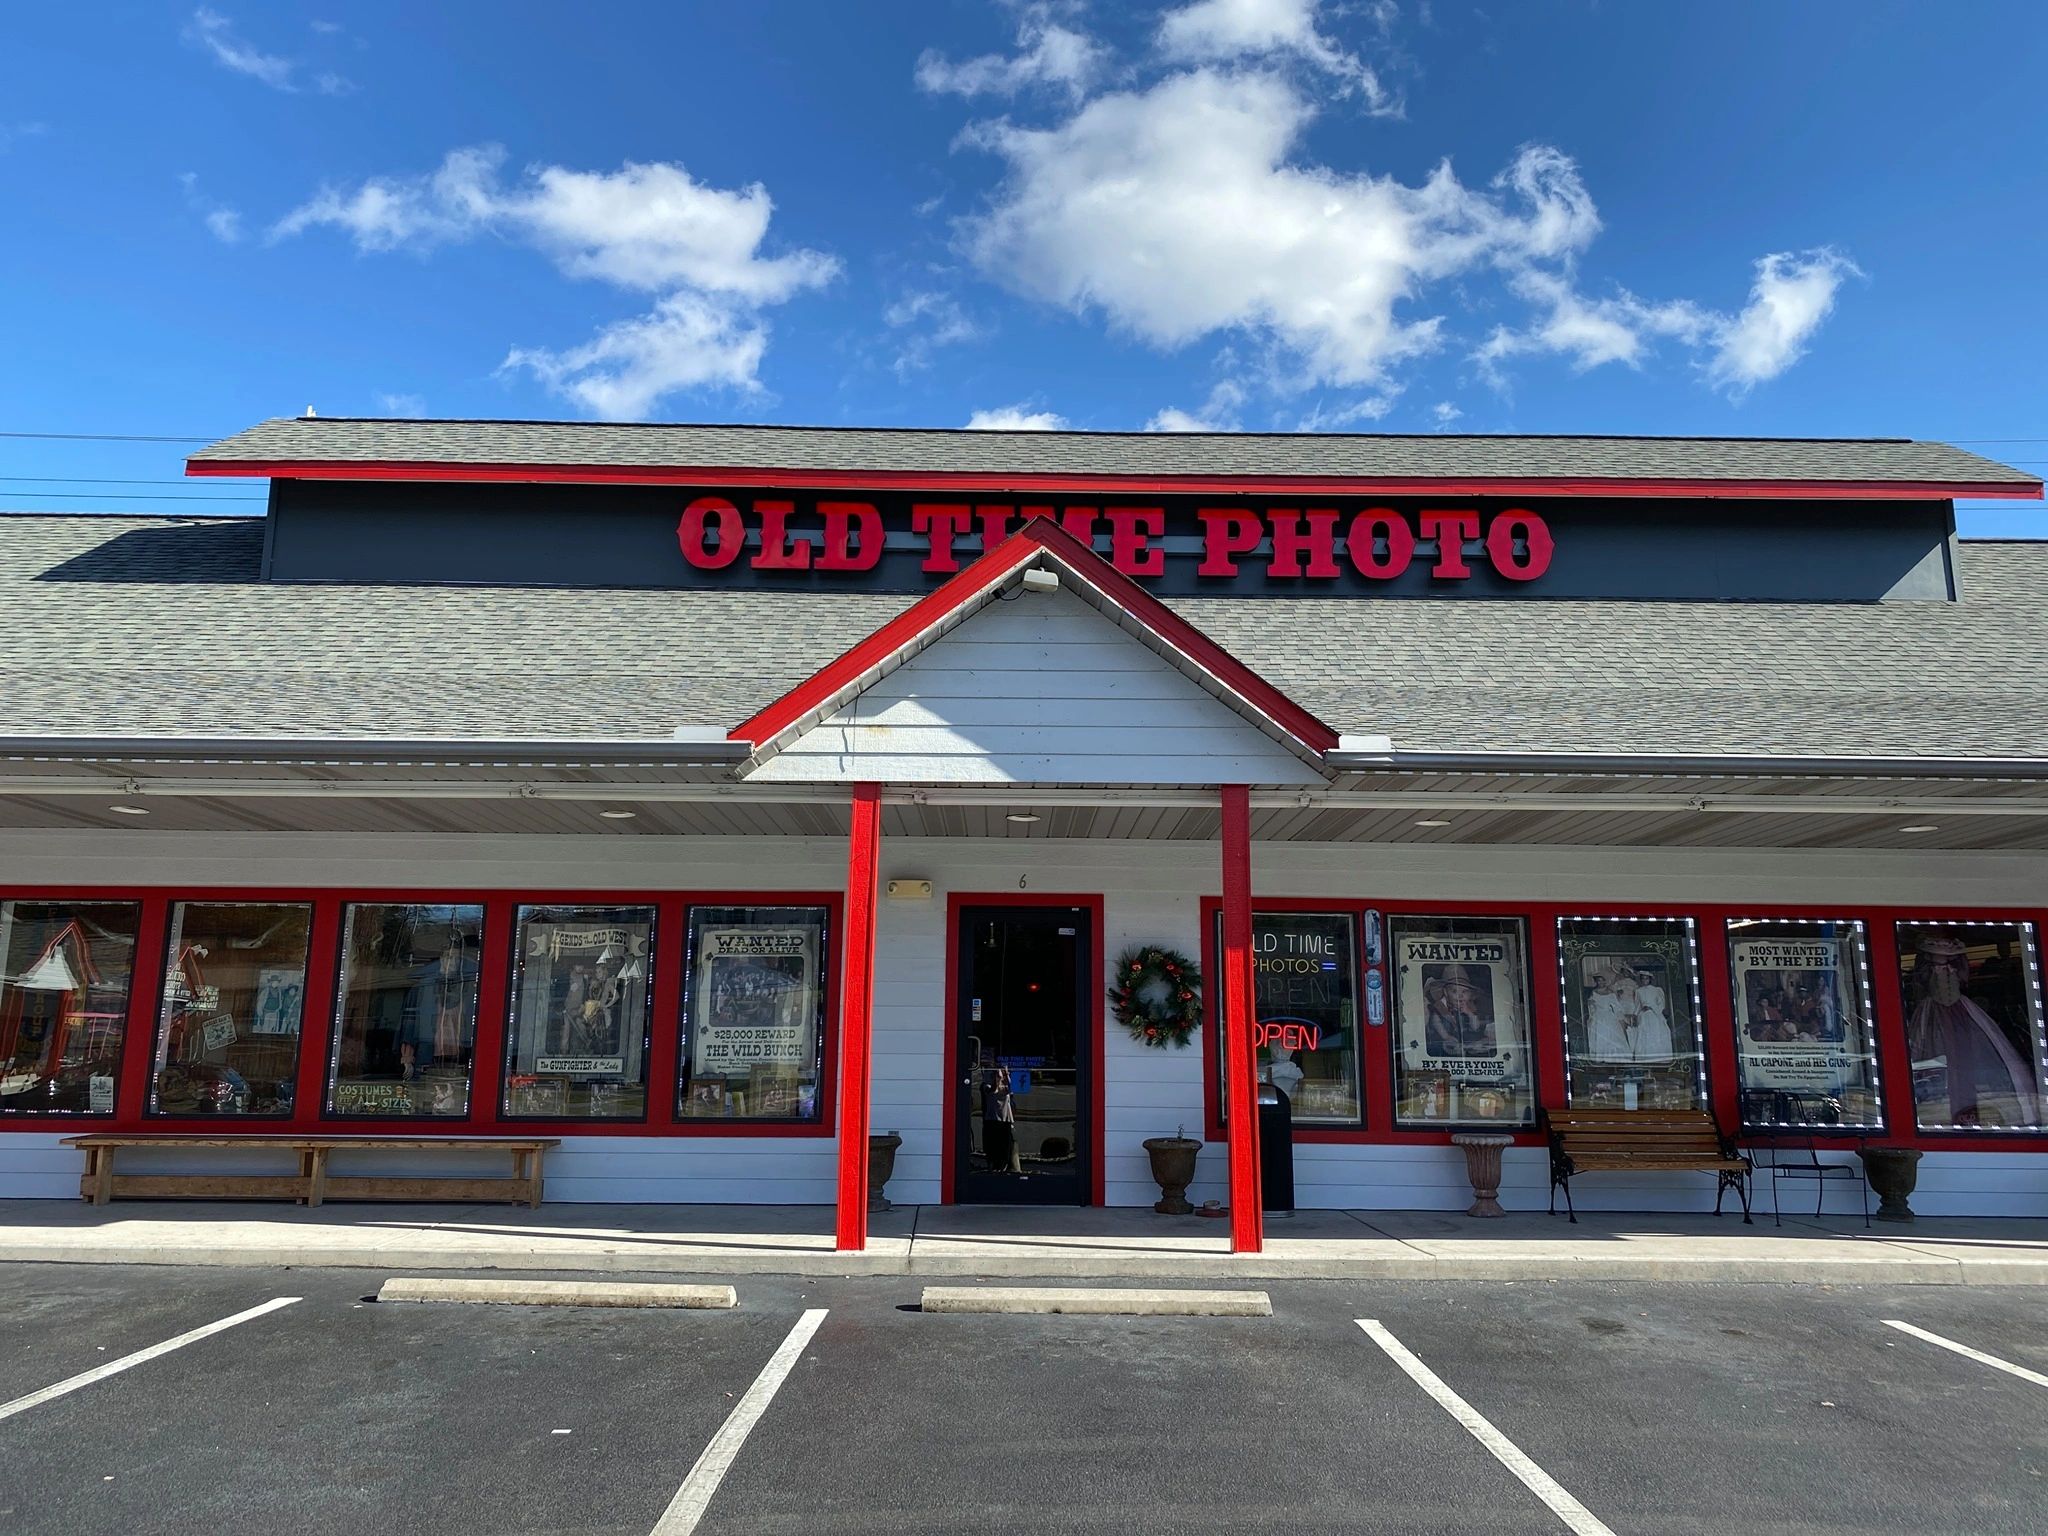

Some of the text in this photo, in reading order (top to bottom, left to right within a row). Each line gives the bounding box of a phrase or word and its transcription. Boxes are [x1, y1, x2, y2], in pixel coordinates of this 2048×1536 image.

[676, 496, 886, 571] OLD
[1196, 507, 1554, 583] PHOTO
[1018, 873, 1027, 889] 6
[715, 936, 804, 947] WANTED
[1252, 933, 1336, 955] LD TIME
[1407, 943, 1503, 961] WANTED
[1749, 946, 1829, 956] MOST WANTED
[1750, 956, 1829, 967] BY THE FBI
[755, 1030, 796, 1040] REWARD
[706, 1044, 803, 1057] THE WILD BUNCH
[549, 1060, 592, 1070] GUNFIGHTER
[1421, 1060, 1504, 1069] BY EVERYONE
[1749, 1057, 1851, 1068] AL CAPONE and HIS GANG
[338, 1085, 393, 1096] COSTUMES
[357, 1095, 378, 1106] ALL
[381, 1097, 413, 1109] SIZES
